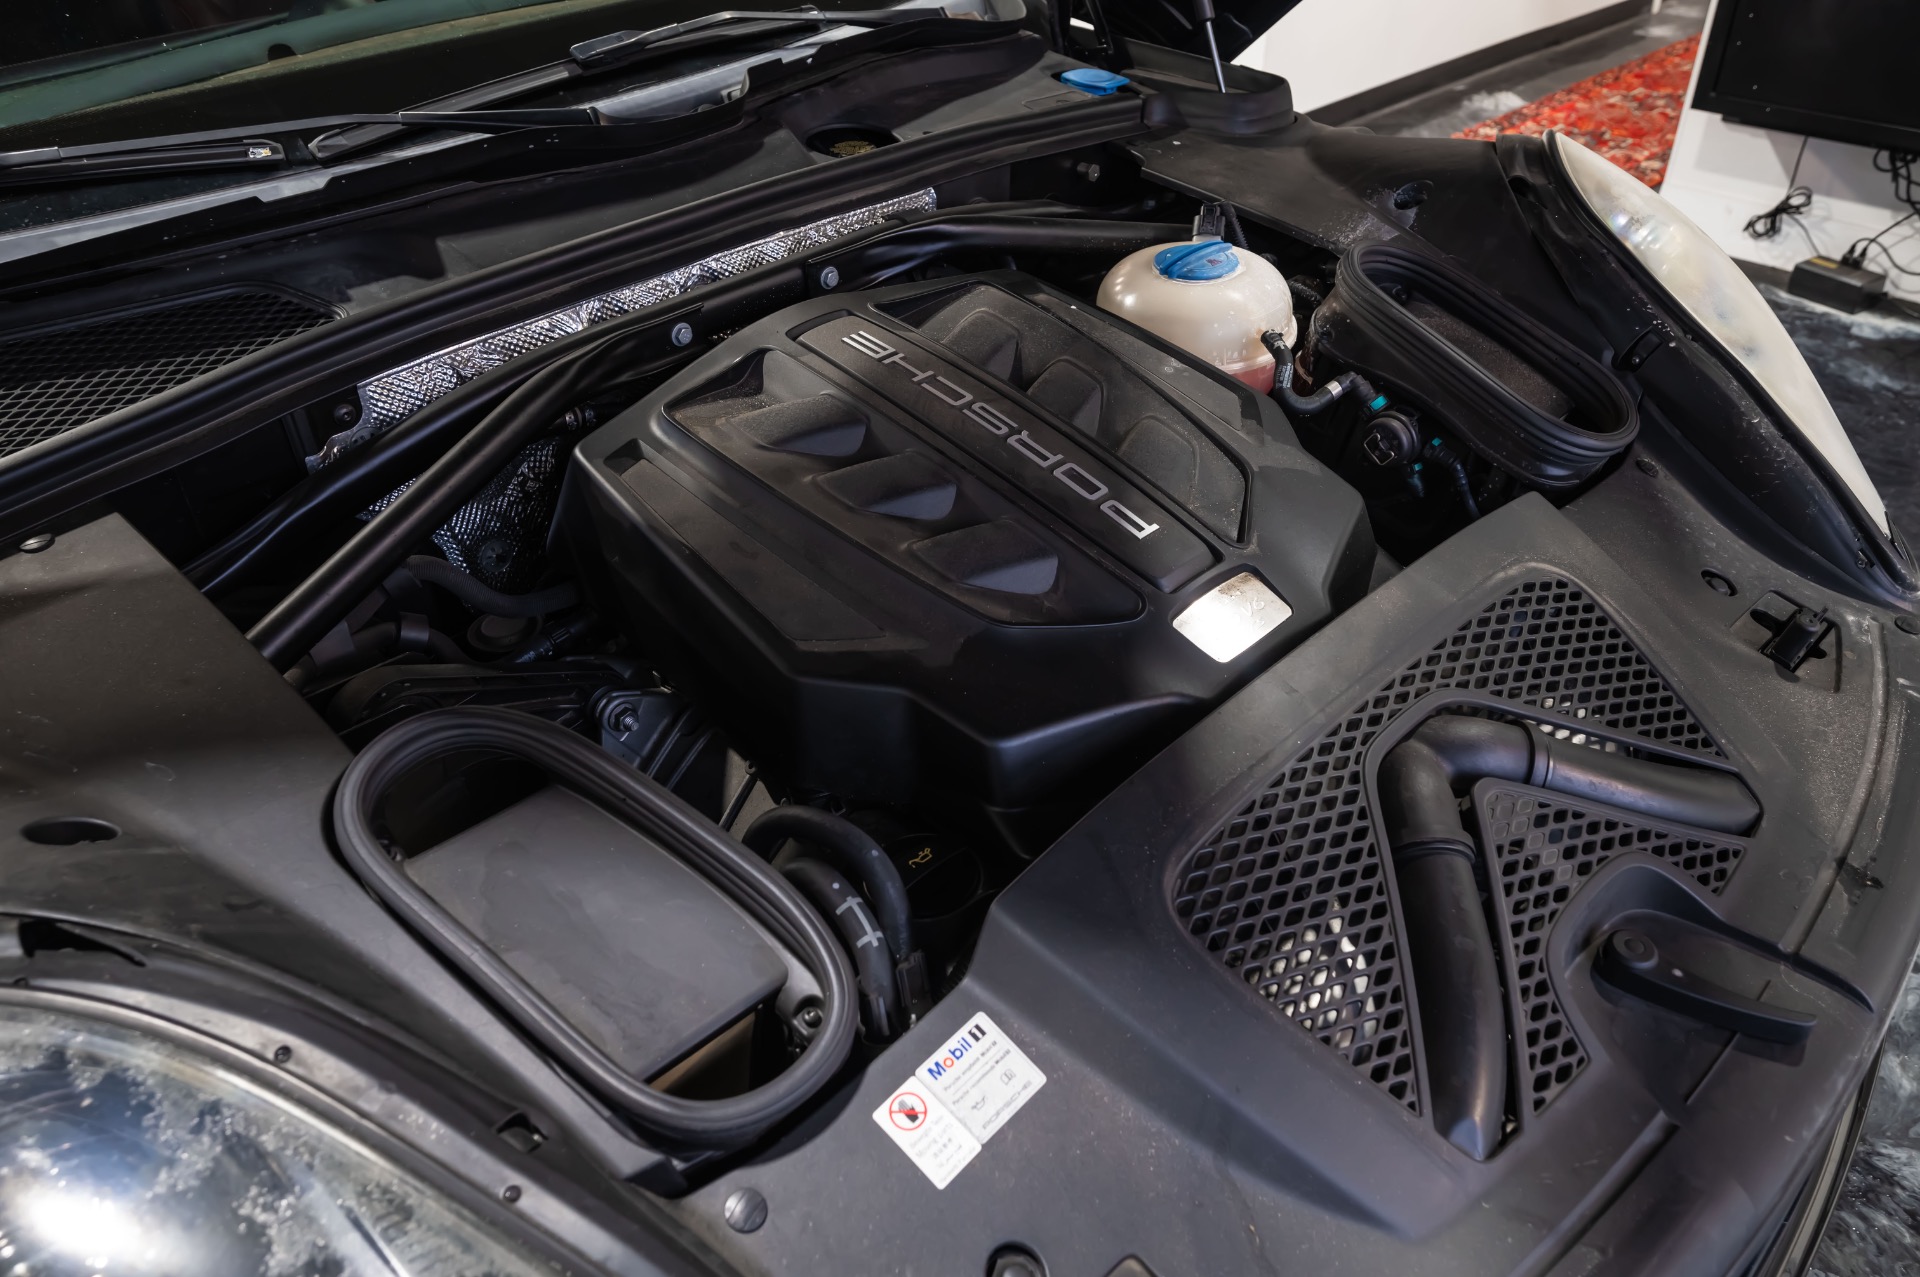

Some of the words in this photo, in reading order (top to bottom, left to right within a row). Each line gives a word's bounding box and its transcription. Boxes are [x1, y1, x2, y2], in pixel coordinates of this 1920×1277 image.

[842, 331, 1160, 540] PORSCHE
[927, 1037, 972, 1080] Mobil
[968, 1024, 987, 1043] 1
